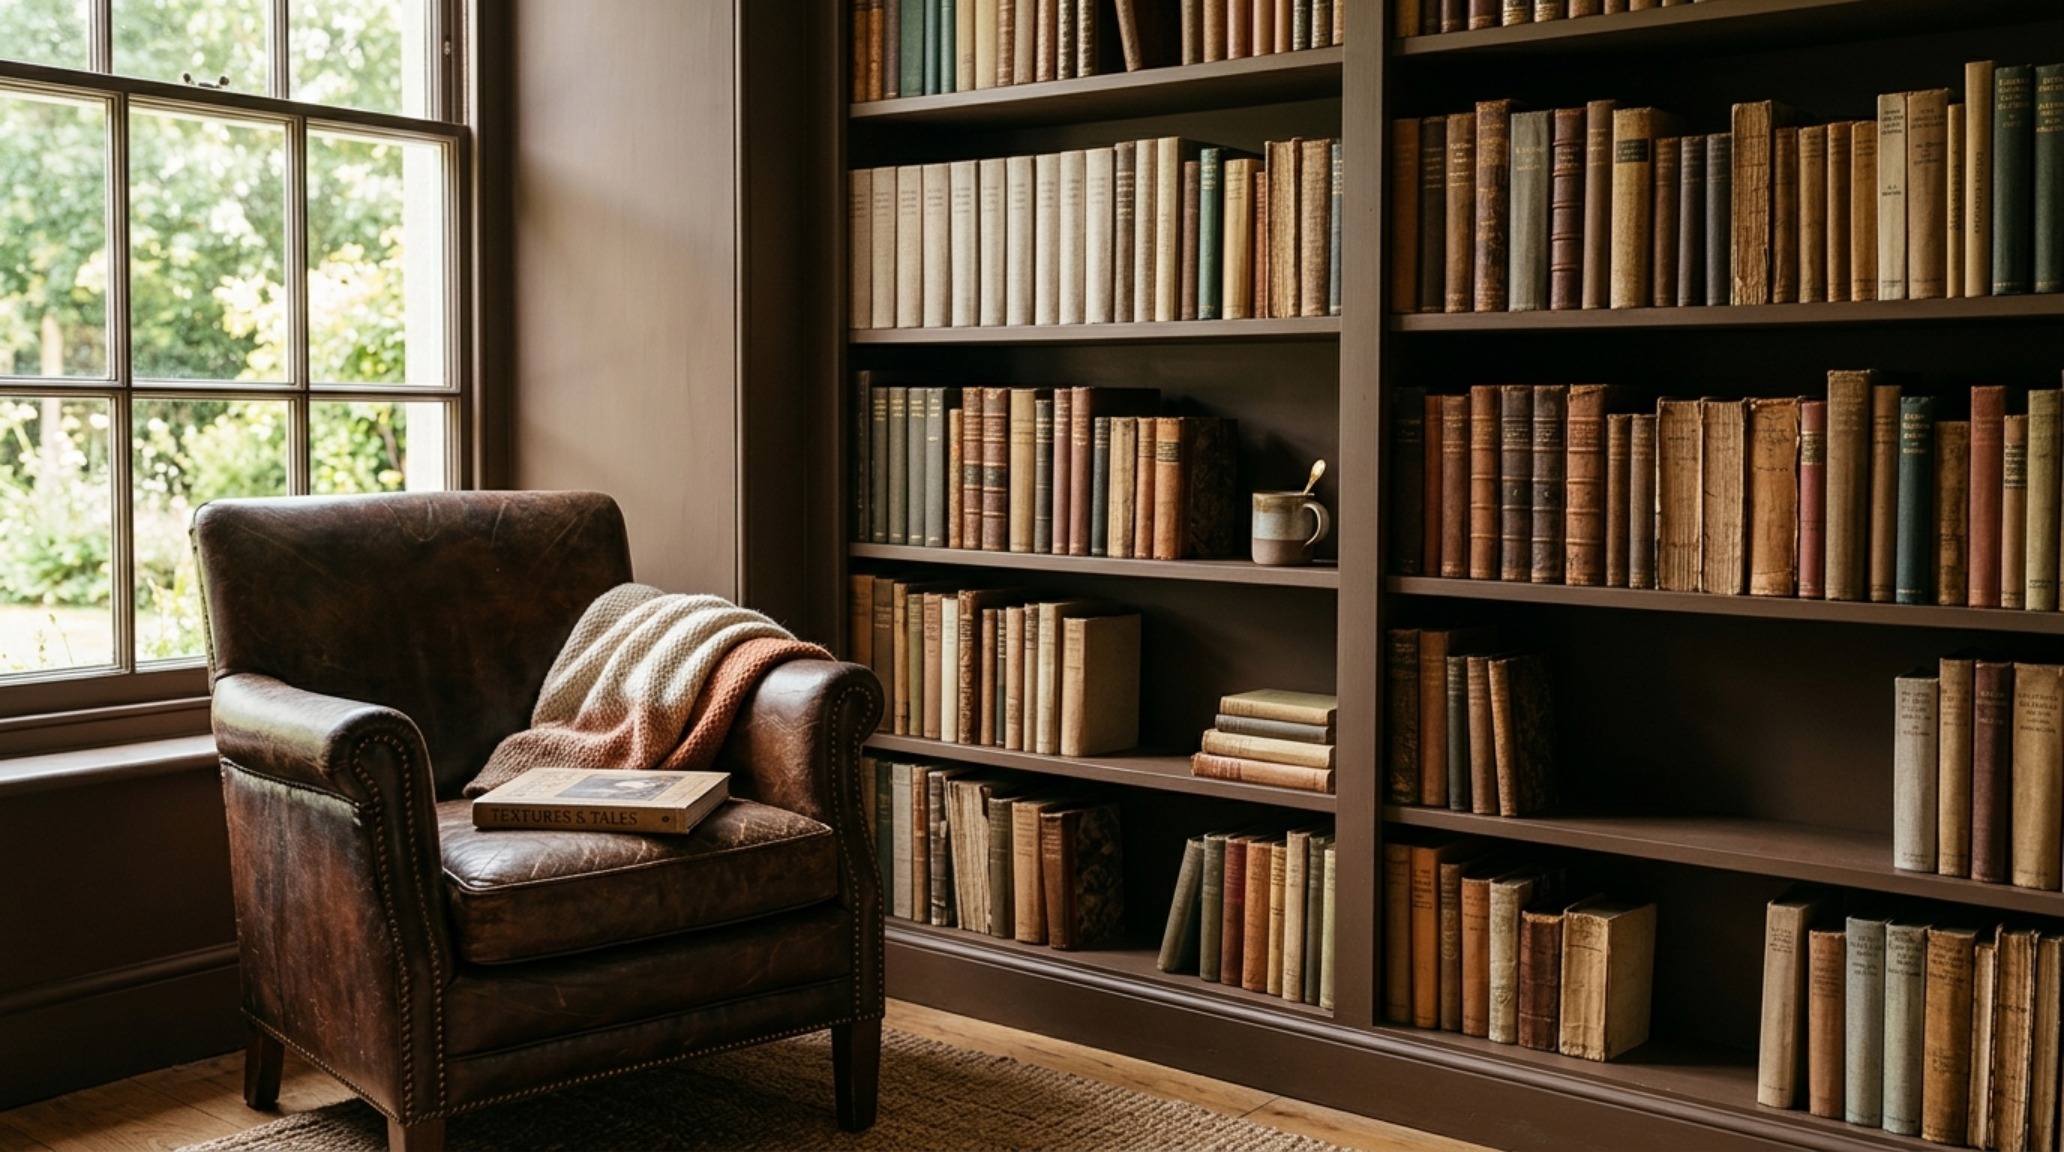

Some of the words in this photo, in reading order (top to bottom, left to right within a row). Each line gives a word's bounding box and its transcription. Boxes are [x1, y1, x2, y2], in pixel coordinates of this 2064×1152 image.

[491, 808, 571, 824] TEXTURES
[575, 811, 586, 824] &
[590, 811, 638, 825] TALES
